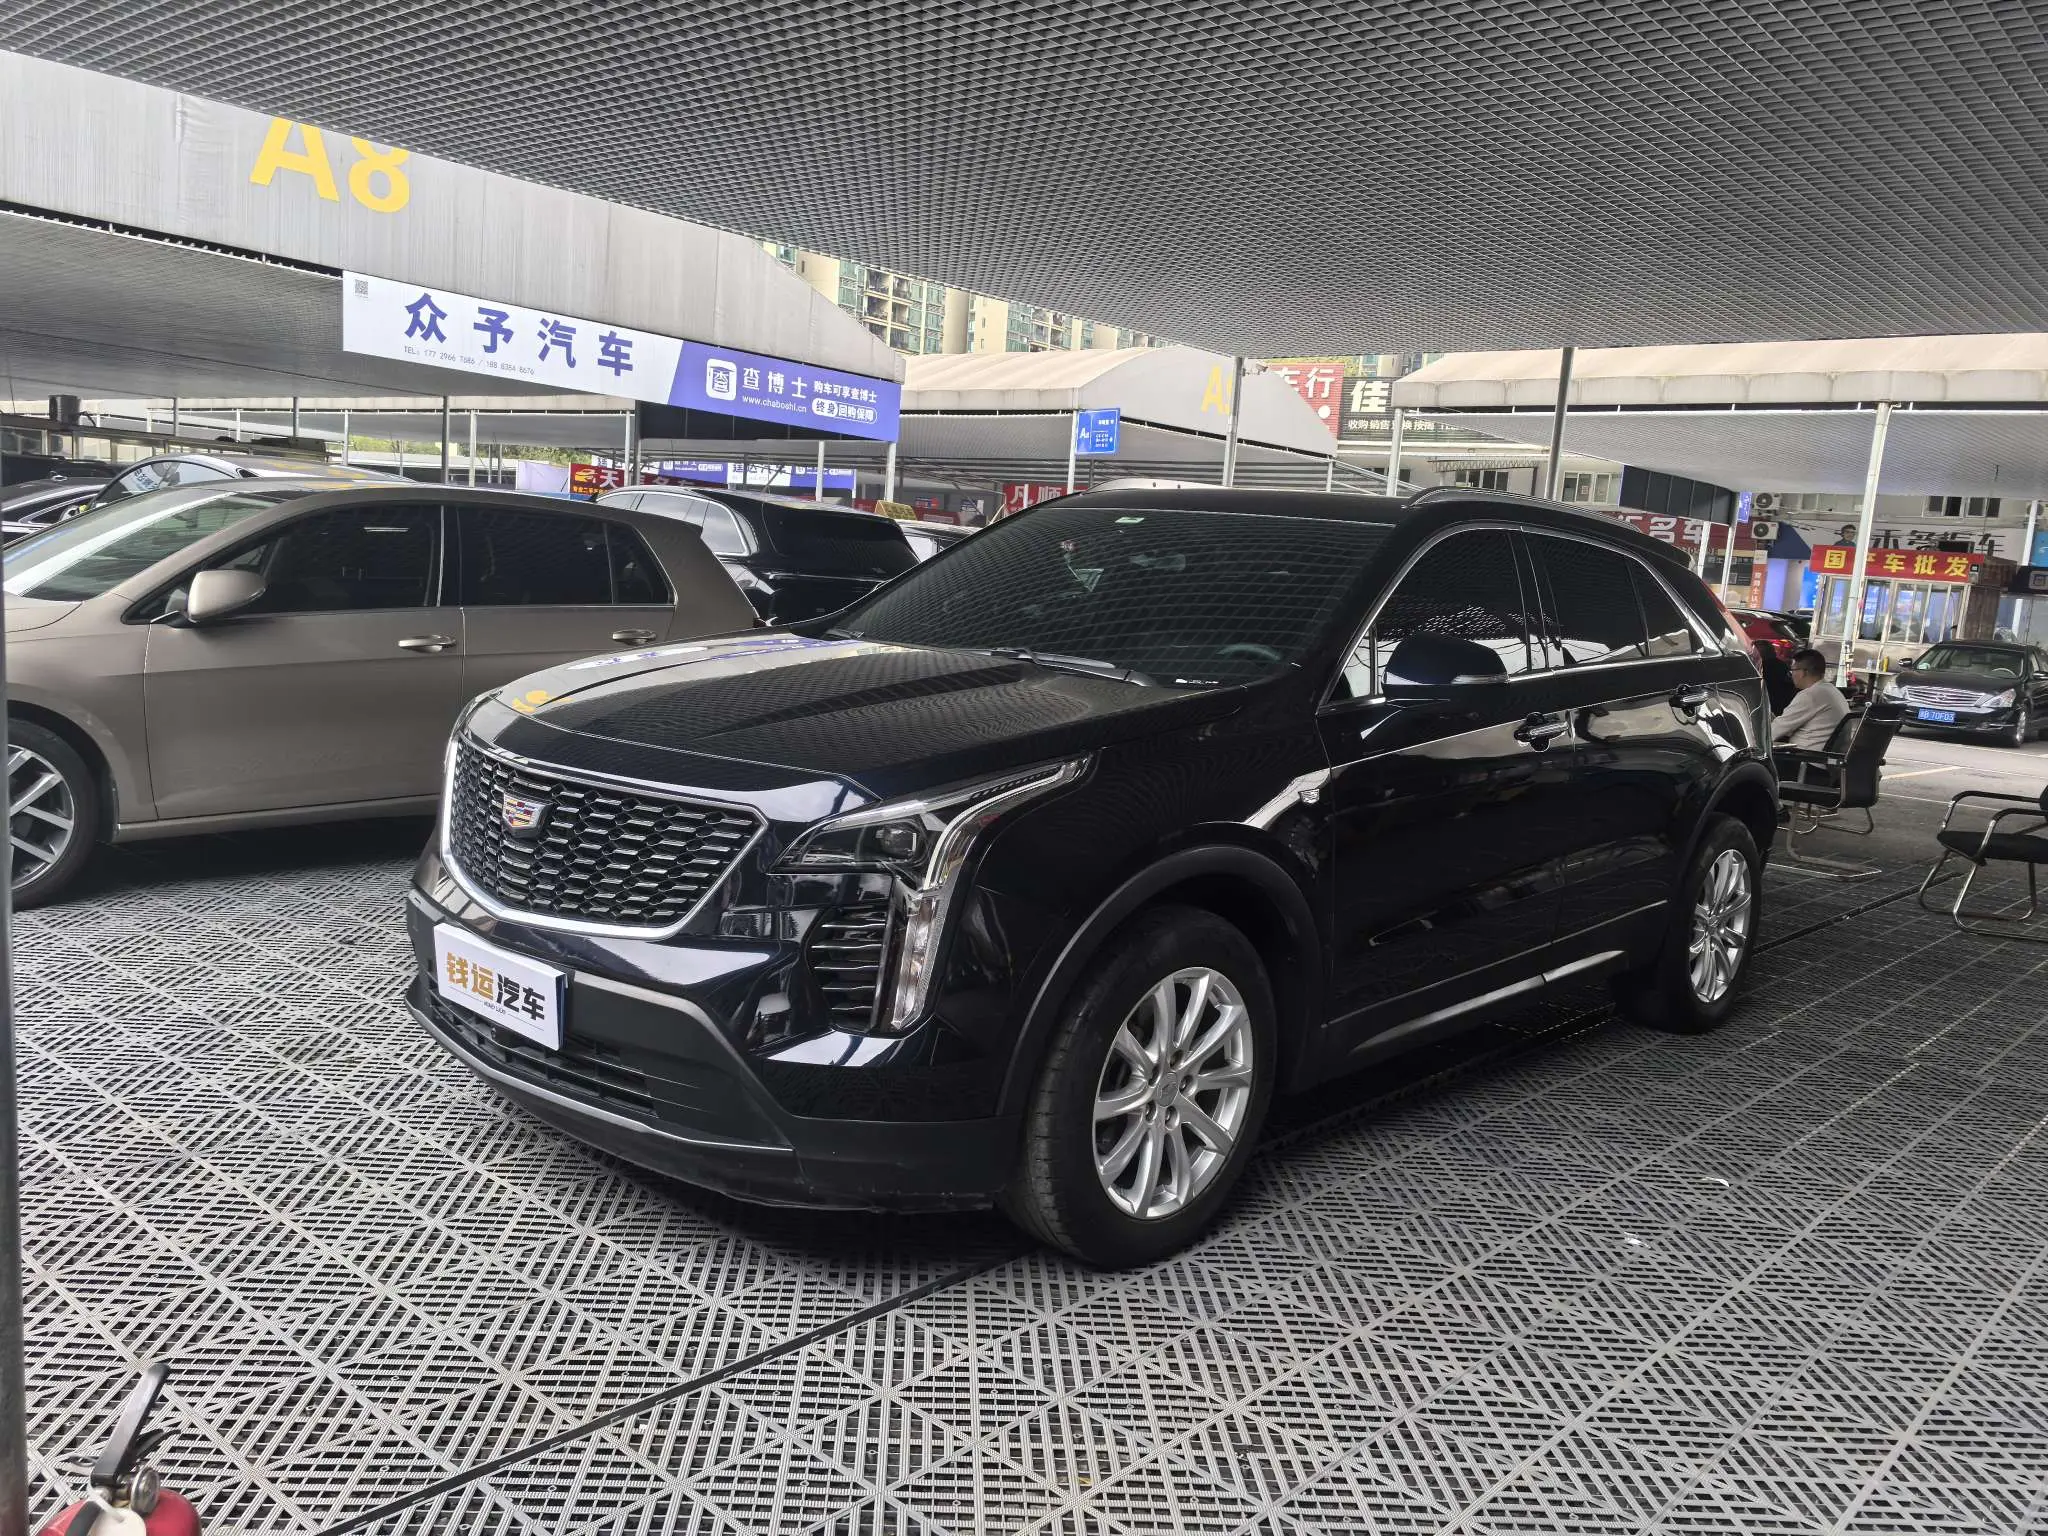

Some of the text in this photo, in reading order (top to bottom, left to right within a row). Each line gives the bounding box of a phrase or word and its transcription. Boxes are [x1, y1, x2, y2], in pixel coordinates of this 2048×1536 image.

[249, 117, 411, 213] A8
[404, 292, 633, 376] 众予汽车
[742, 368, 807, 399] 查博士
[813, 380, 877, 403] 购车可享查博士
[1350, 380, 1389, 412] 佳
[742, 395, 807, 413] www.chaboshi.cn
[447, 952, 545, 1020] 钱运汽车
